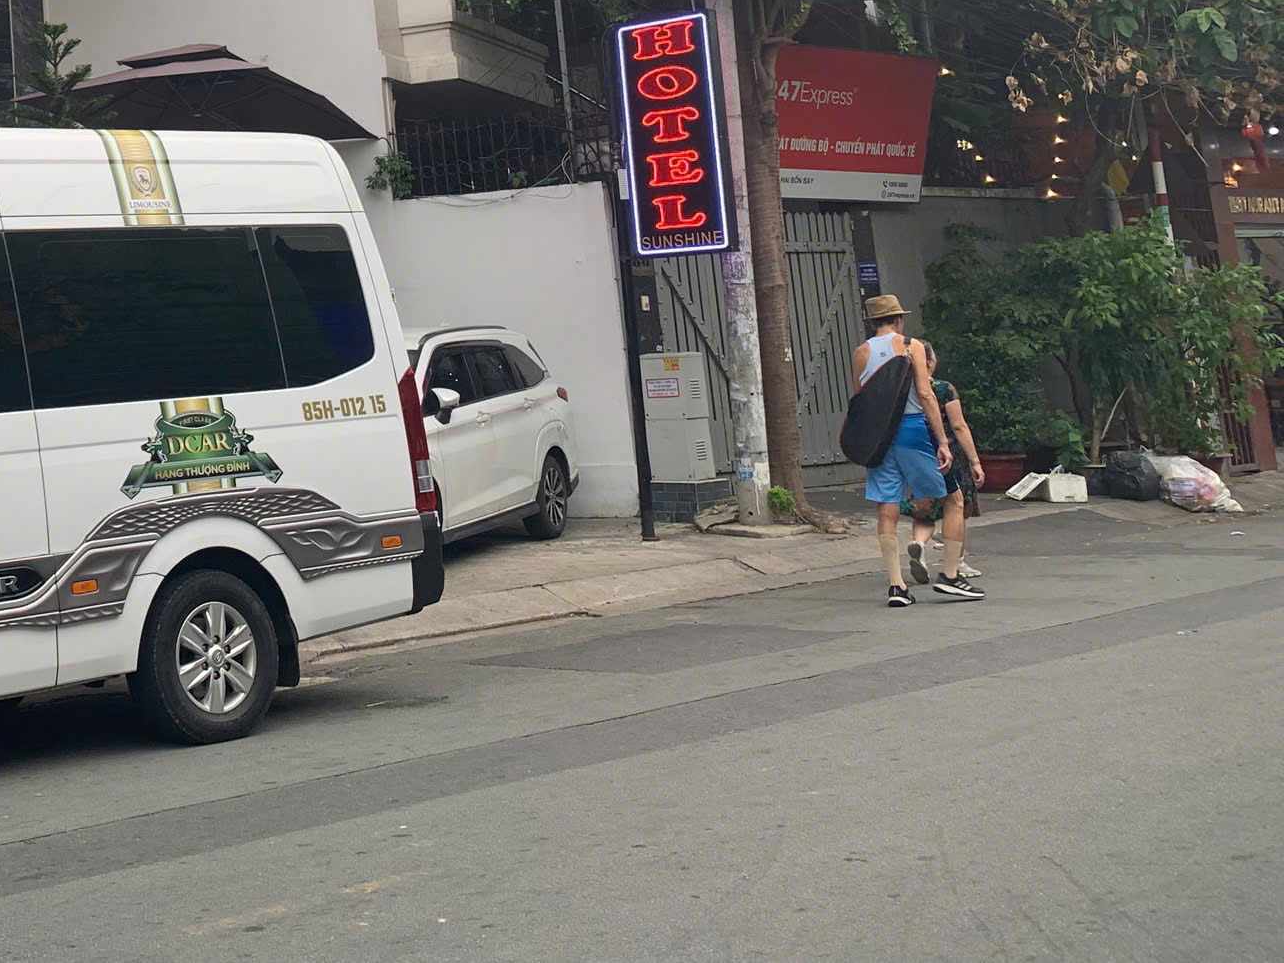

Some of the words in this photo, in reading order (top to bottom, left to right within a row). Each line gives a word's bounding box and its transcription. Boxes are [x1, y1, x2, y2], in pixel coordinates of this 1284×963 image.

[631, 20, 708, 230] HOTEL
[818, 138, 829, 155] BỘ
[866, 141, 885, 155] PHÁT
[129, 200, 173, 209] LIMOUSINE
[642, 230, 723, 250] SUNSHINE
[301, 396, 366, 421] 85H-012
[368, 394, 386, 414] 15
[166, 431, 232, 455] DCAR
[155, 468, 184, 481] HẠNG
[185, 464, 225, 477] THƯỢNG
